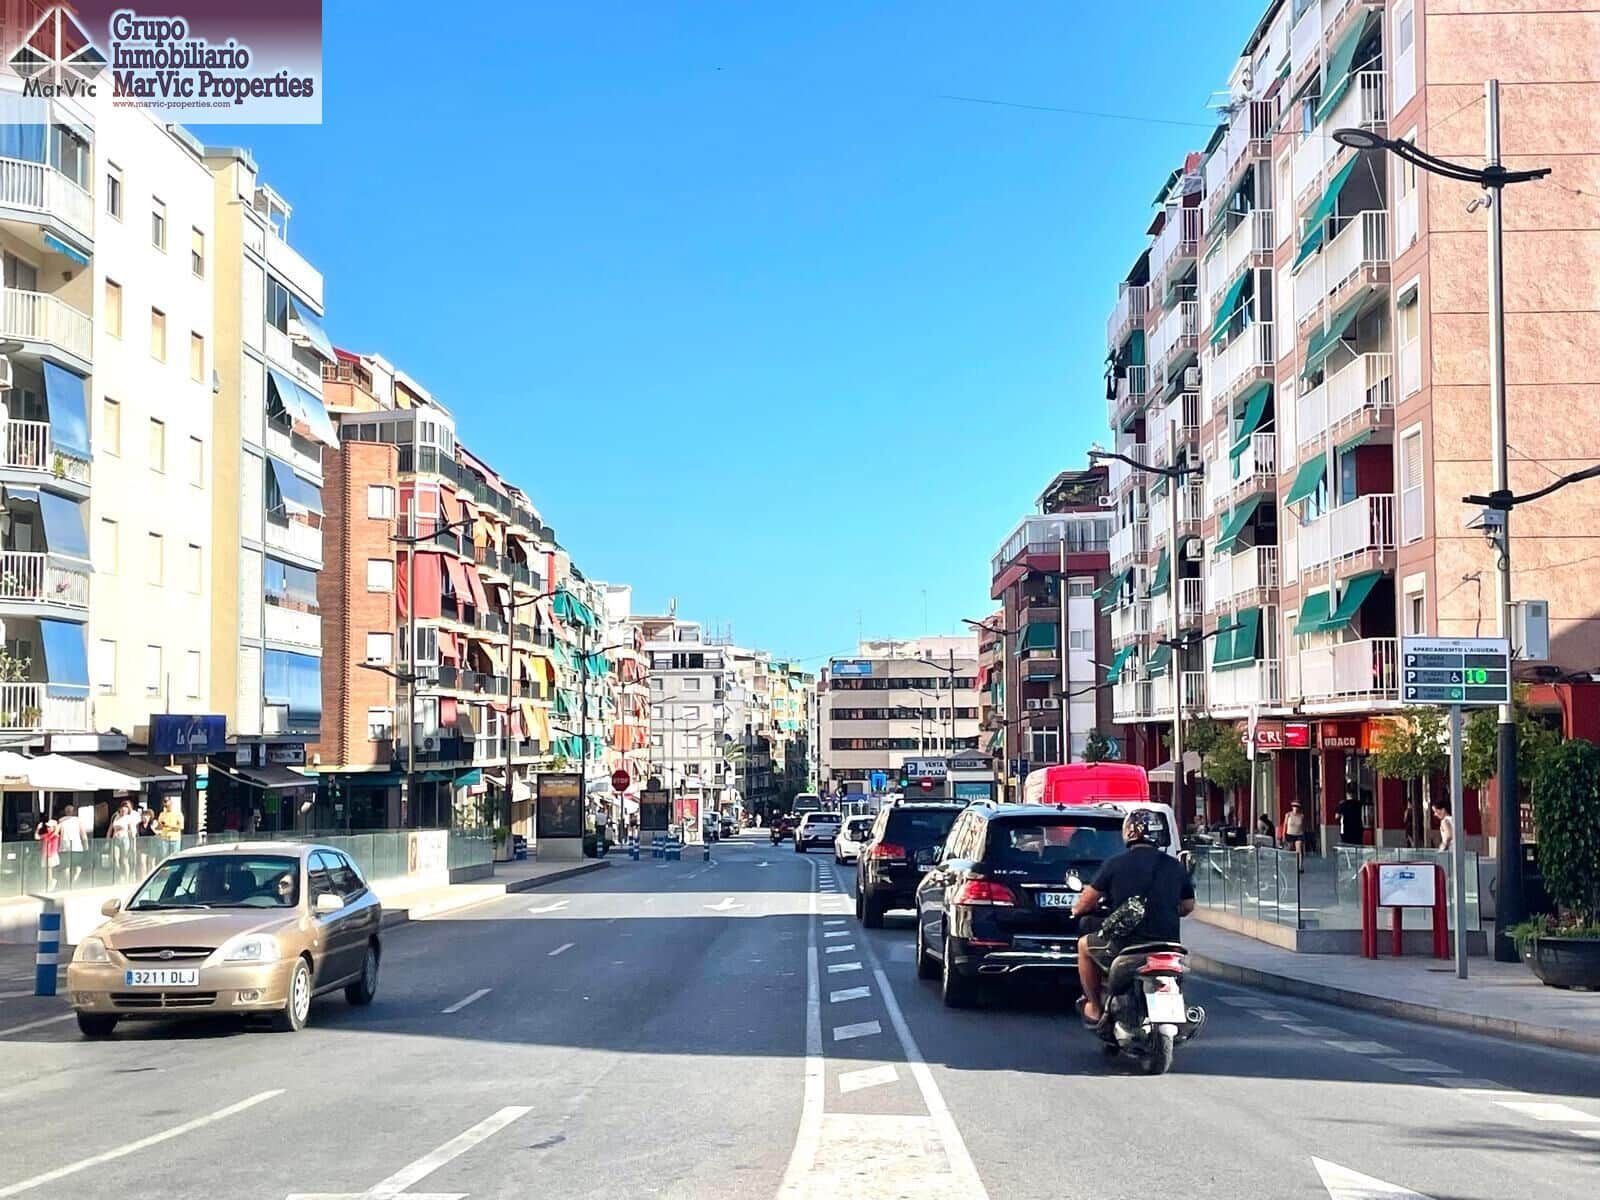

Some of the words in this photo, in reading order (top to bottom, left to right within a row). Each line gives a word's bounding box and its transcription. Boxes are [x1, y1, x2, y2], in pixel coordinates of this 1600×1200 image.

[1407, 655, 1416, 667] P
[1407, 671, 1416, 682] P
[1407, 687, 1416, 698] P
[907, 763, 916, 775] P
[613, 777, 628, 785] STOP
[135, 971, 165, 984] 3211
[170, 971, 195, 984] DLJ
